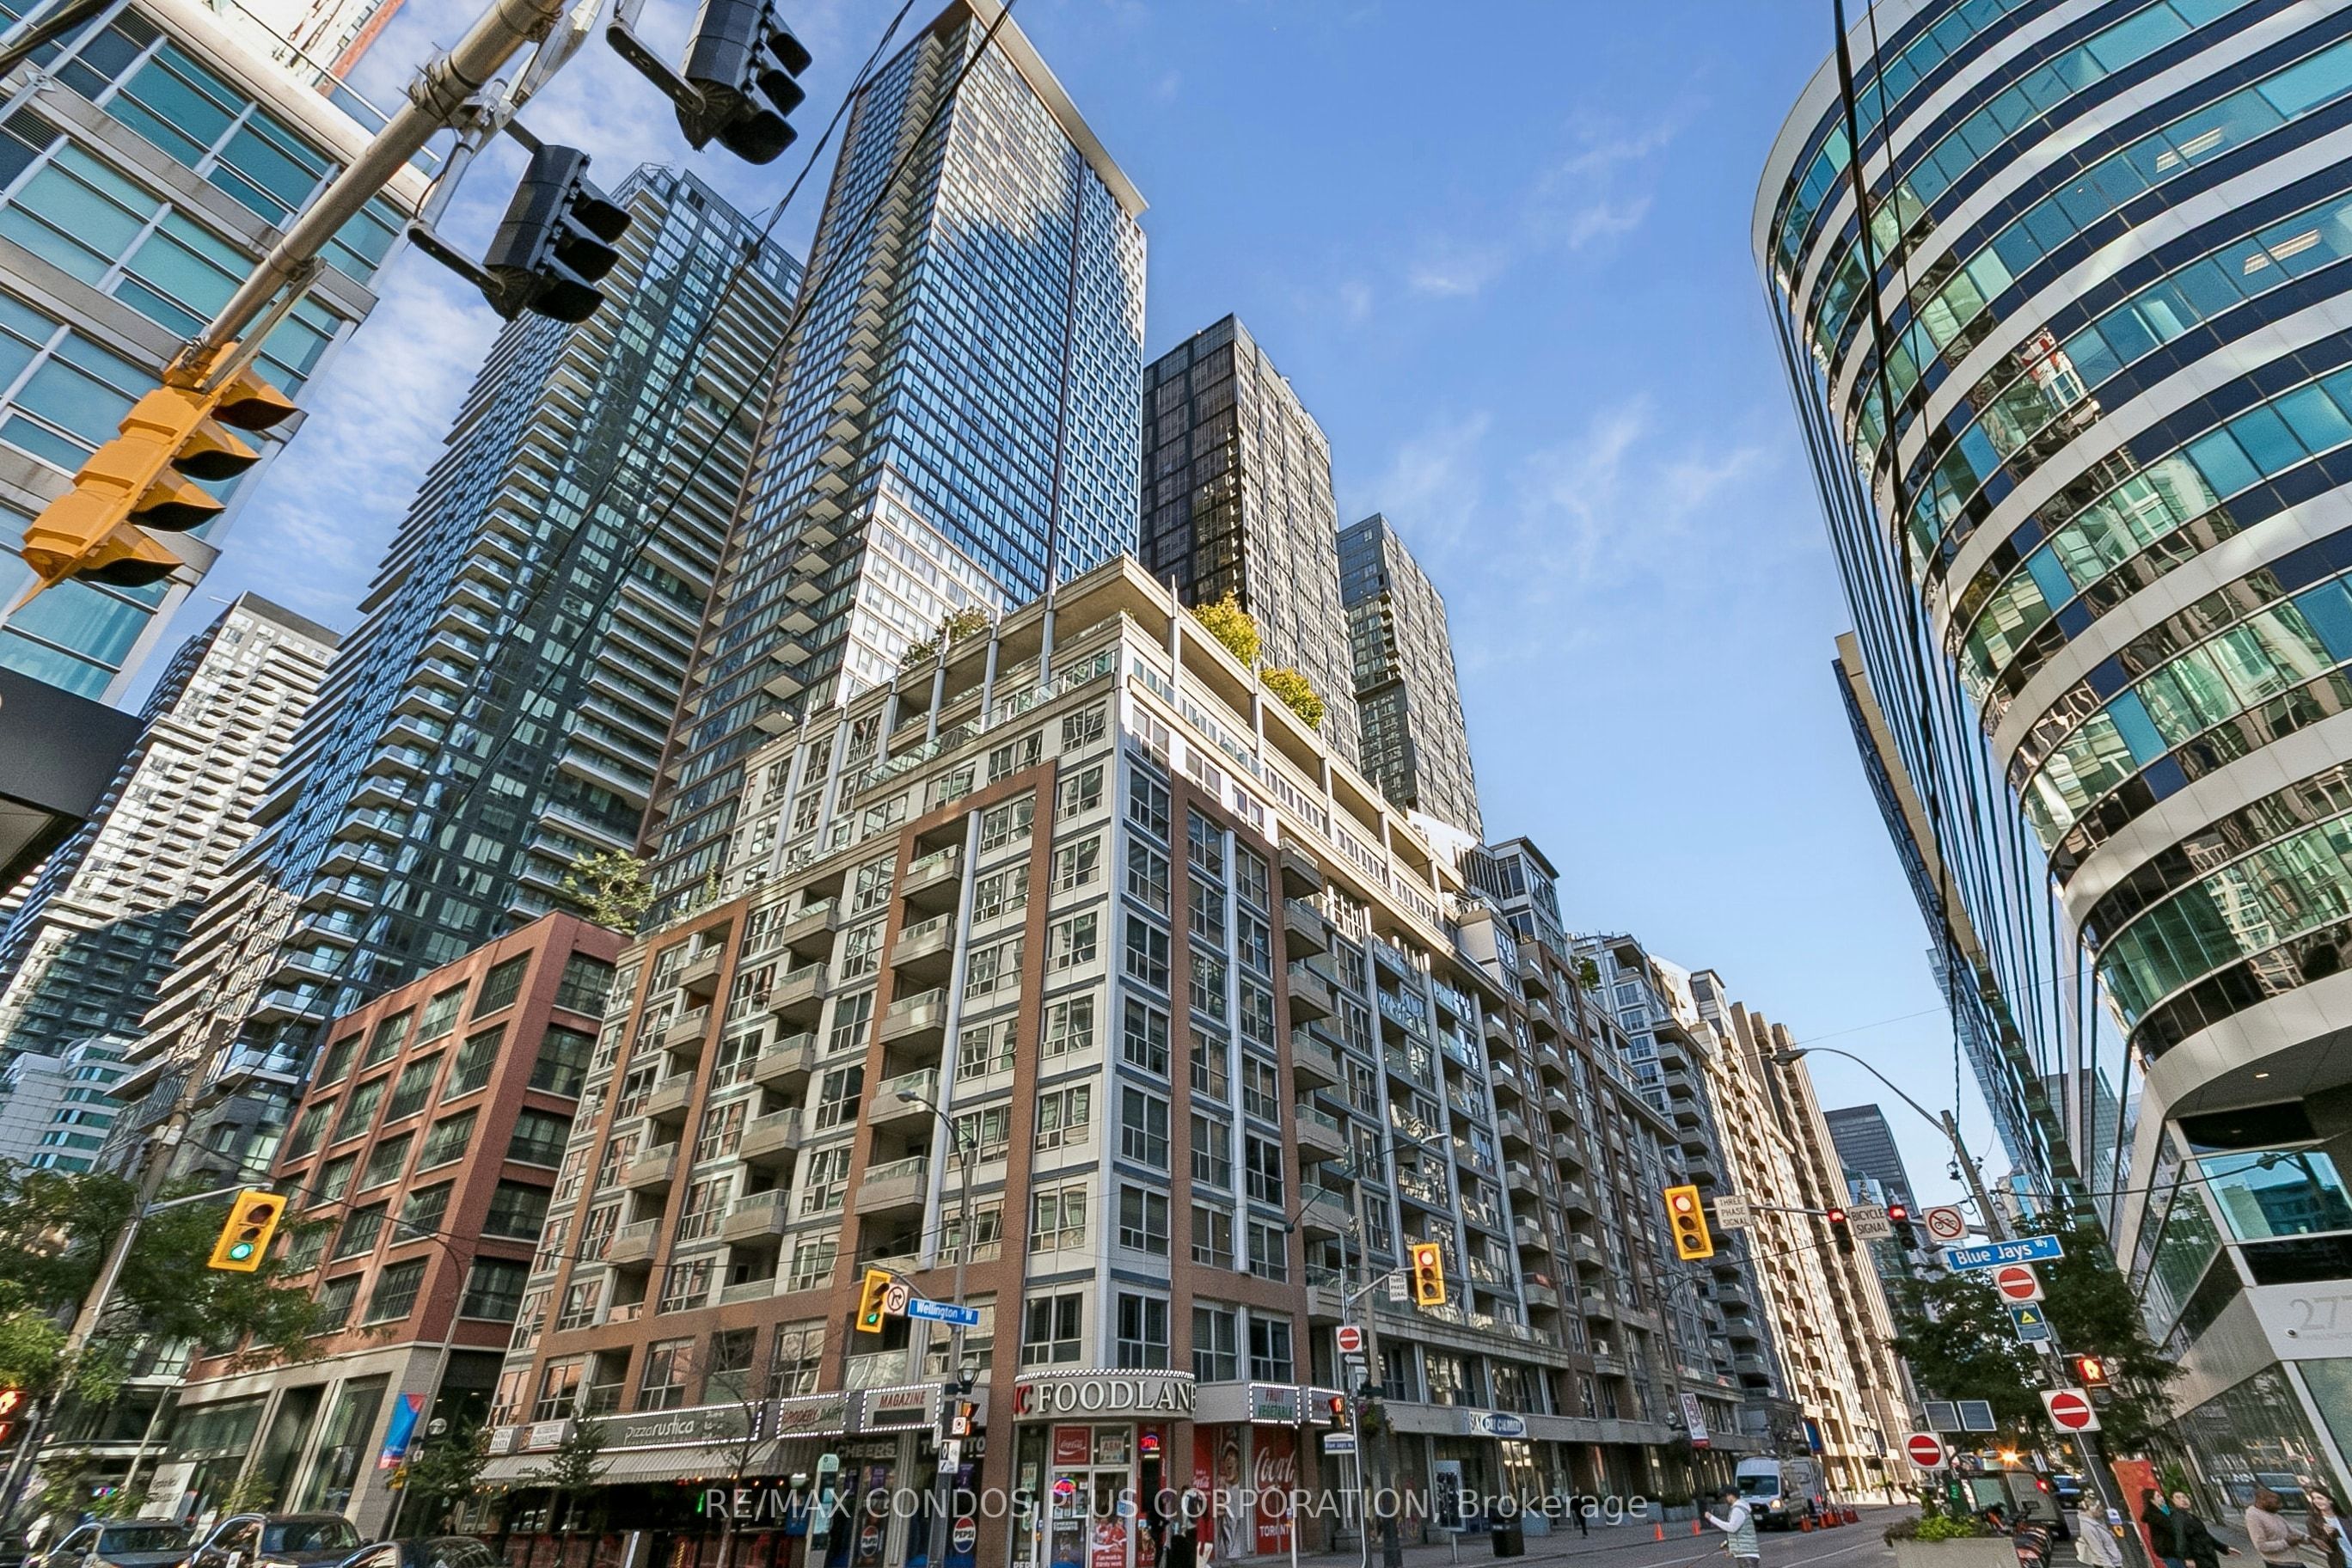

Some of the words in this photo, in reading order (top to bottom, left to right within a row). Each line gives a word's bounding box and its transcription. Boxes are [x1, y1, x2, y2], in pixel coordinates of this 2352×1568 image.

[1721, 1208, 1746, 1216] PHASE
[1851, 1209, 1885, 1222] BICYCLE
[1723, 1217, 1749, 1227] SIGNAL
[1857, 1222, 1888, 1235] SIGNAL
[1955, 1248, 1992, 1265] Blue
[1997, 1244, 2033, 1260] Jays
[2034, 1238, 2049, 1248] Wy
[916, 1301, 958, 1320] Wellington
[965, 1309, 973, 1320] W
[879, 1390, 926, 1408] MAGAZINE
[1265, 1388, 1284, 1403] FRUIT
[782, 1408, 817, 1424] GROCERY
[1259, 1404, 1293, 1418] VEGETABLE
[836, 1442, 897, 1458] CHEERS
[955, 1528, 974, 1540] PEPSI
